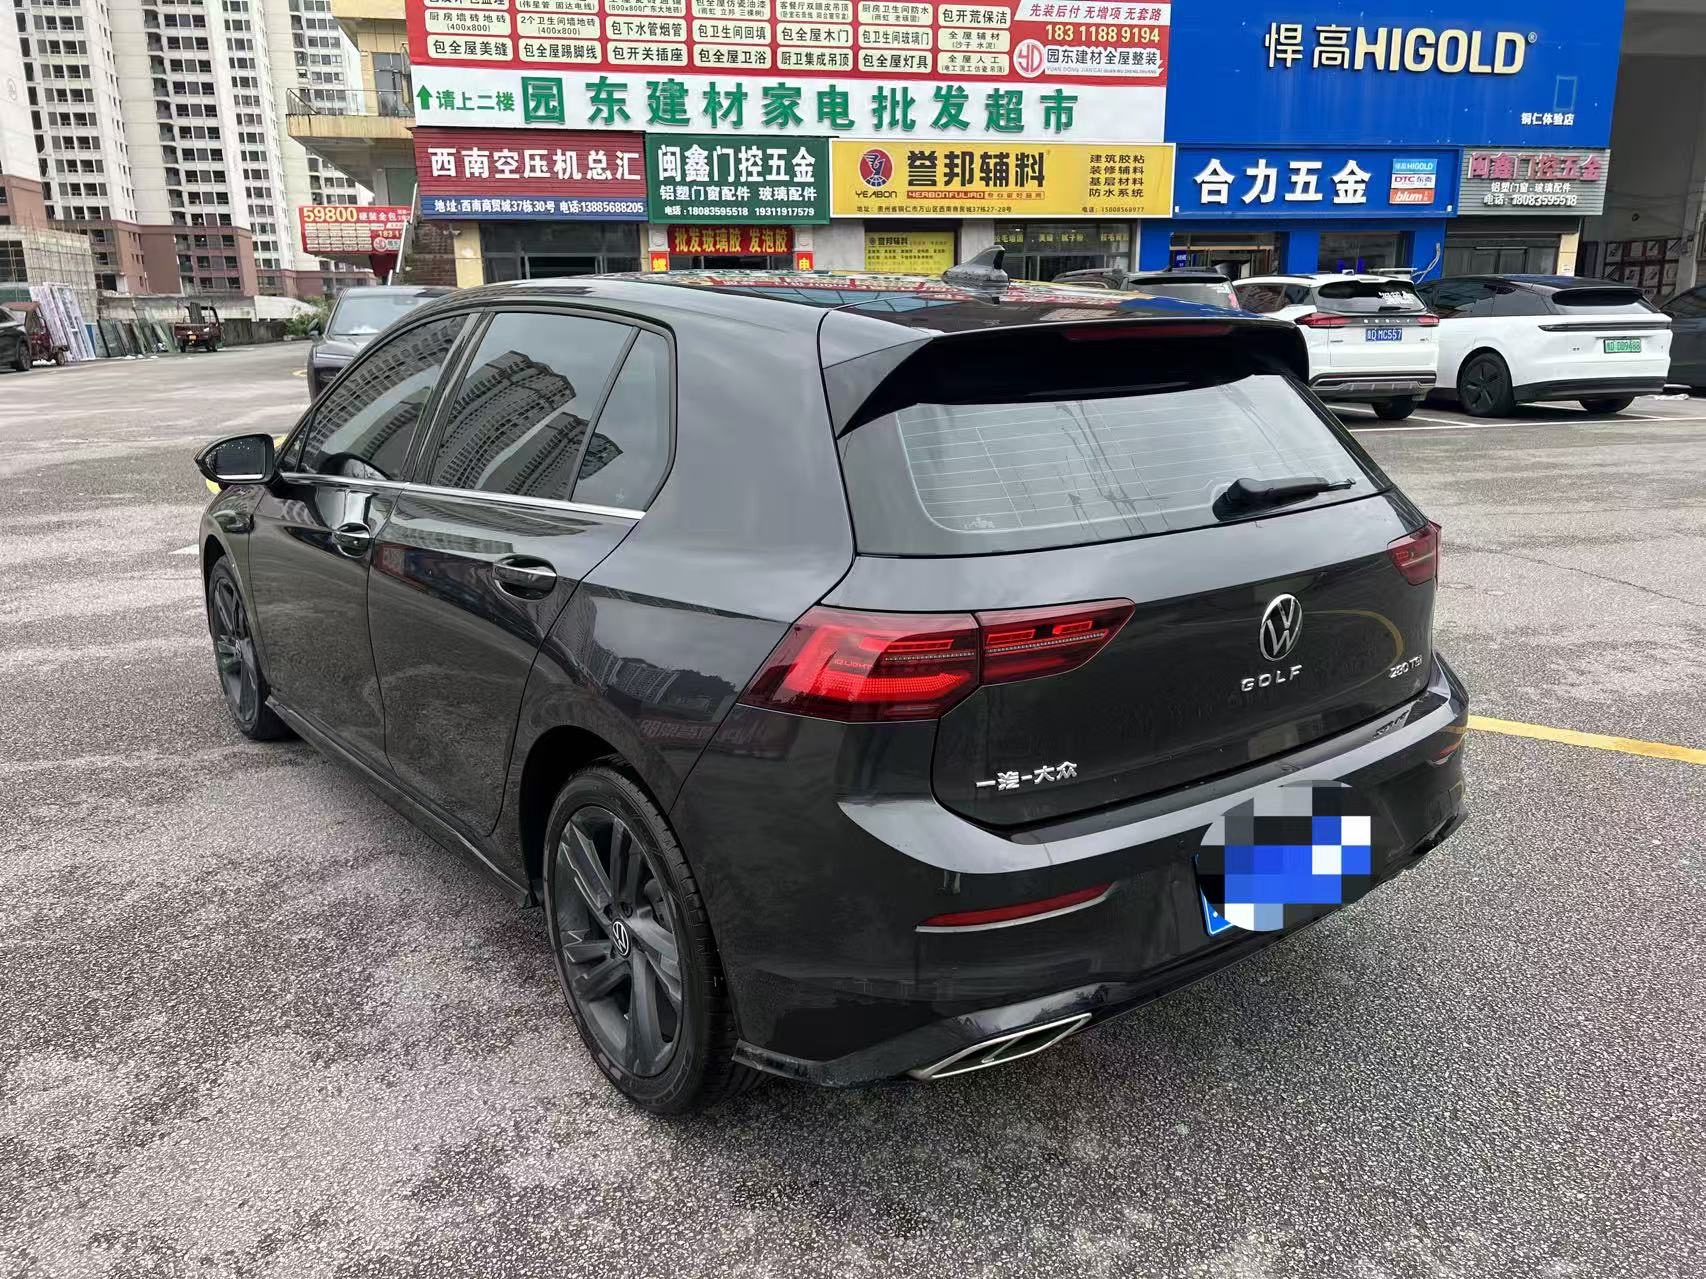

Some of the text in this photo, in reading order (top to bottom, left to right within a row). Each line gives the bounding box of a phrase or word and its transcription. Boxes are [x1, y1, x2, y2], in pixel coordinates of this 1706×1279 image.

[862, 4, 929, 14] 厨房卫生间防水
[942, 8, 1008, 25] 包开荒保洁
[1030, 3, 1162, 21] 先装后付 无增项 无套路
[429, 12, 506, 23] 厨房墙砖地砖
[520, 16, 596, 26] 2个卫生间墙地砖
[447, 23, 491, 32] (400x800)
[537, 27, 581, 35] (400x800)
[611, 21, 683, 37] 包下水管烟管
[698, 24, 767, 40] 包卫生间回填
[781, 26, 849, 43] 包全屋木门
[1045, 24, 1160, 44] 183 1188 9194
[862, 29, 930, 46] 包卫生间玻璃门
[948, 31, 1000, 41] 全屋辅材
[433, 39, 509, 57] 包全屋美缝
[523, 43, 598, 60] 包全屋踢脚线
[612, 46, 684, 62] 包开关插座
[698, 48, 768, 65] 包全屋卫浴
[781, 51, 849, 67] 厨卫集成吊顶
[862, 53, 929, 69] 包全屋灯具
[948, 54, 1000, 64] 全屋人工
[1046, 48, 1158, 66] 园东建材全屋整装
[435, 90, 515, 112] 请上二楼
[520, 75, 1079, 135] 园东建材家电批发超市
[1521, 112, 1574, 126] 铜仁体验店
[428, 147, 641, 180] 西南空压机总汇
[657, 144, 816, 182] 闽鑫门控五金
[1089, 154, 1145, 164] 建筑胶粘
[1467, 152, 1602, 181] 闽鑫门控五金
[907, 150, 1045, 188] 誉邦辅料
[1089, 165, 1145, 175] 装修辅料
[1089, 177, 1144, 187] 基层材料
[1194, 158, 1371, 205] 合力五金
[659, 185, 818, 201] 铝塑门窗配件 玻璃配件
[1089, 188, 1144, 198] 防水系统
[1395, 191, 1424, 202] blum
[303, 207, 357, 222] 59800
[754, 207, 815, 216] 19311917579
[675, 228, 788, 253] 批发玻璃胶 发泡胶
[1240, 665, 1303, 692] GOLF
